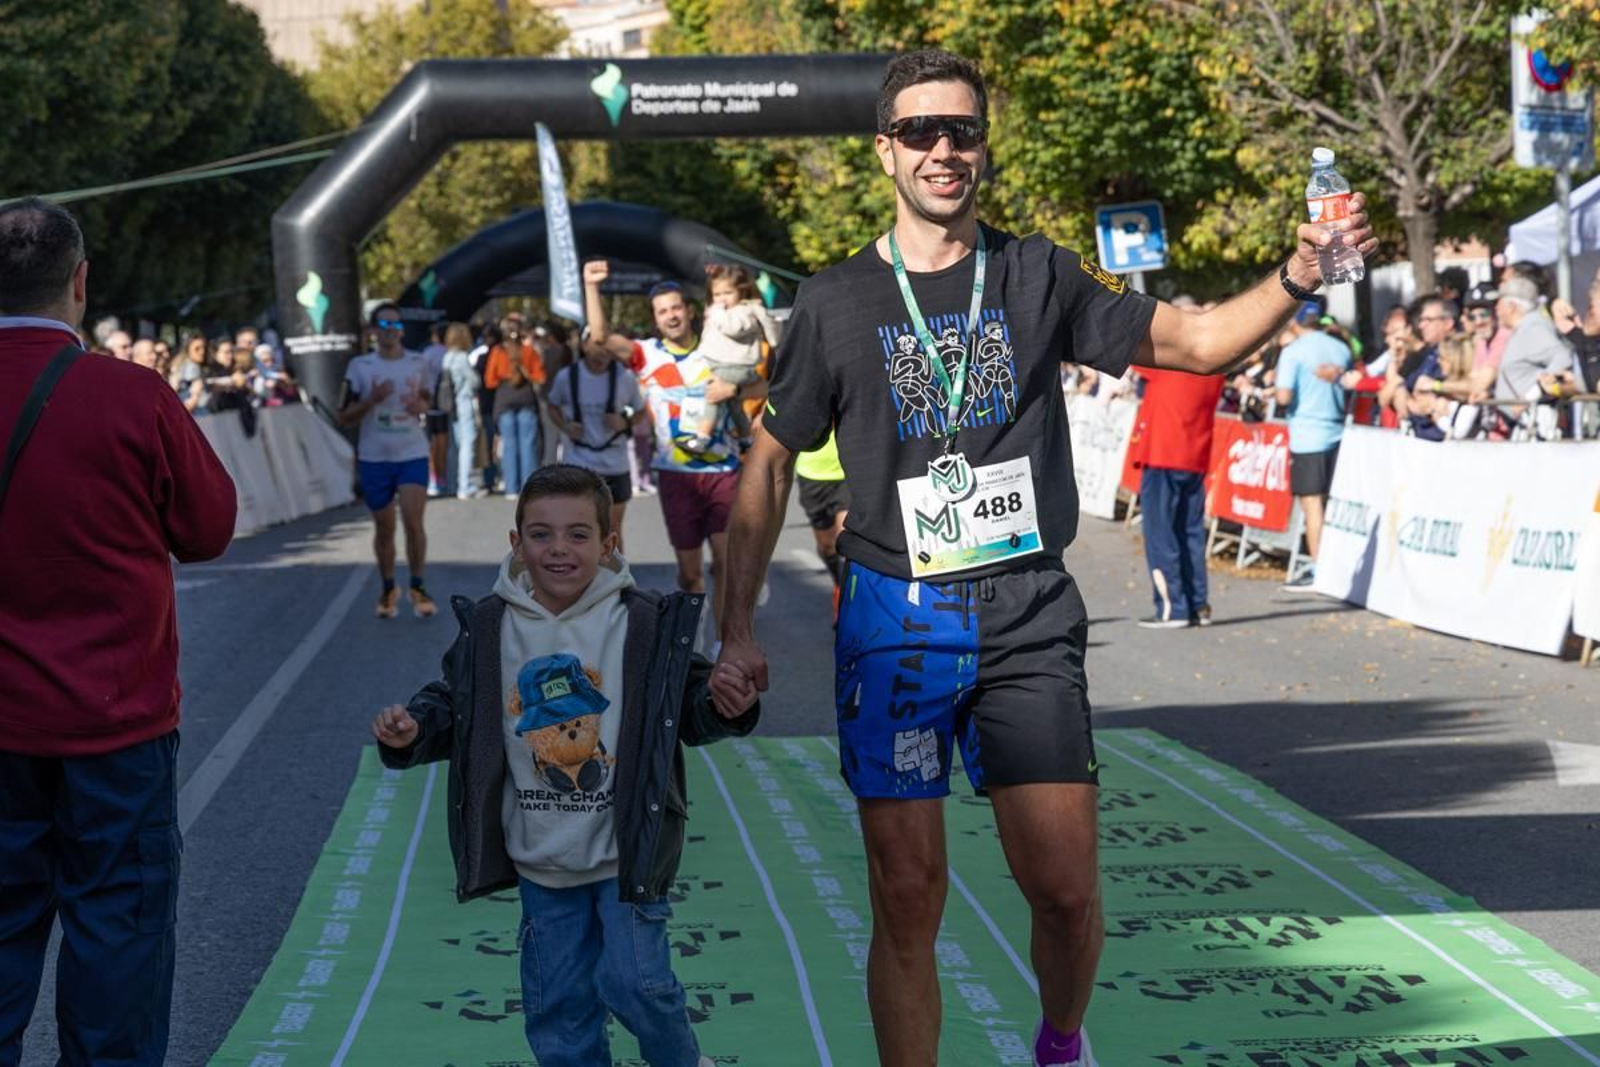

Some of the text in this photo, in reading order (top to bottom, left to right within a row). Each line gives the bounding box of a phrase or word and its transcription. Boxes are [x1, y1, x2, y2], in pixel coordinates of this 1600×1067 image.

[631, 81, 798, 98] Patronato Municipal de
[631, 98, 760, 116] Deportes de Jaén
[1111, 212, 1151, 265] P
[973, 491, 1022, 520] 488
[554, 803, 594, 813] TODAY
